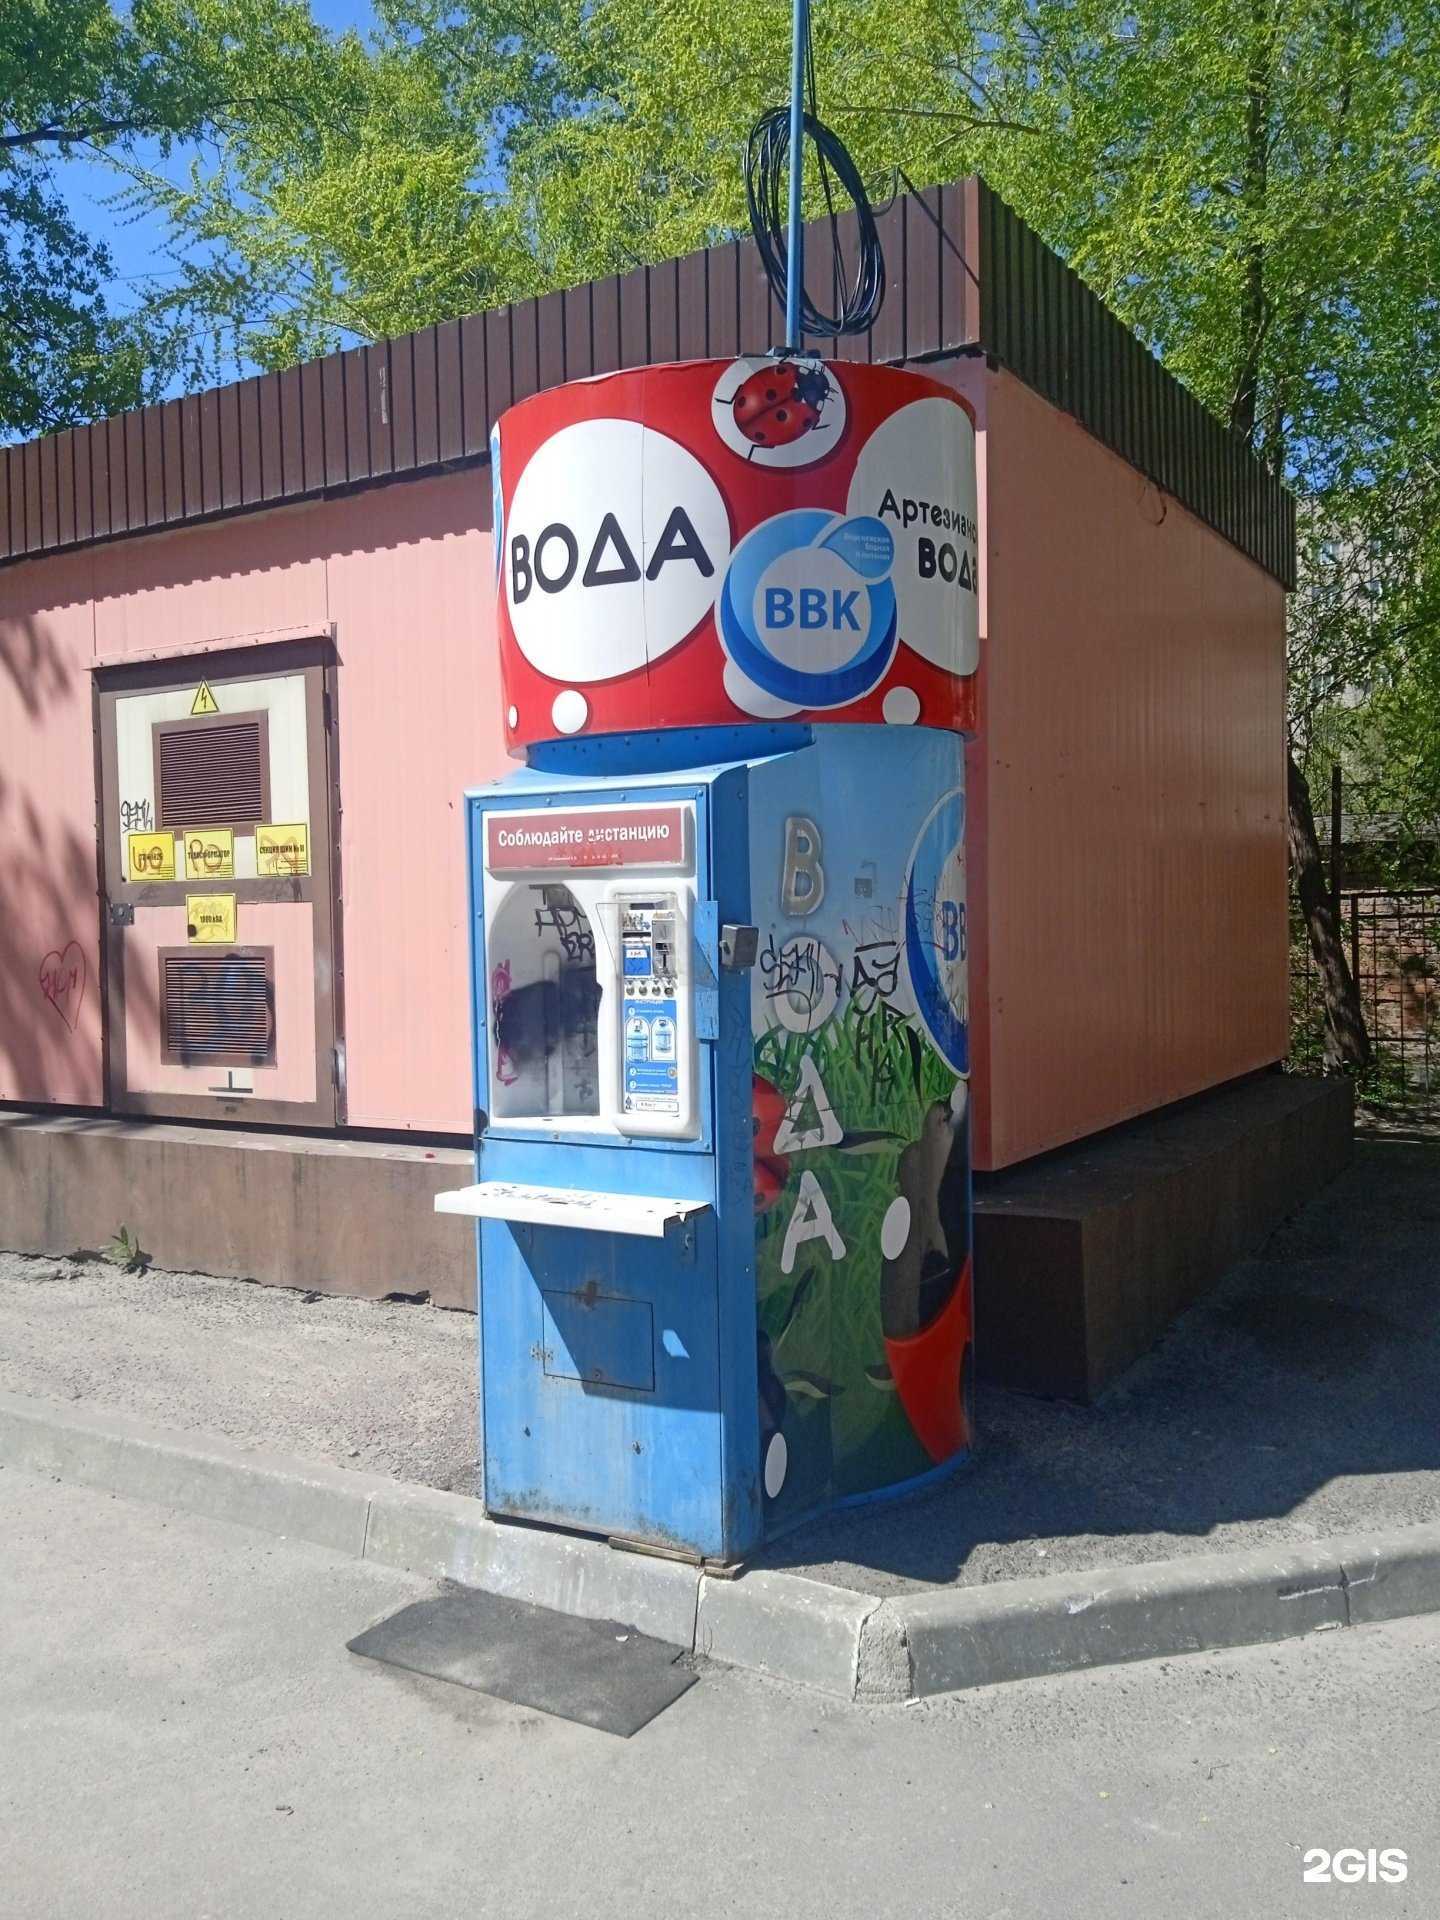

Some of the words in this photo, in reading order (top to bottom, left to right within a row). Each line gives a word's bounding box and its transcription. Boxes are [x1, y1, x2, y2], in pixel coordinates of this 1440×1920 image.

[511, 505, 715, 605] ВОДА
[765, 586, 861, 632] ВВК
[498, 826, 584, 847] Соблюдайте
